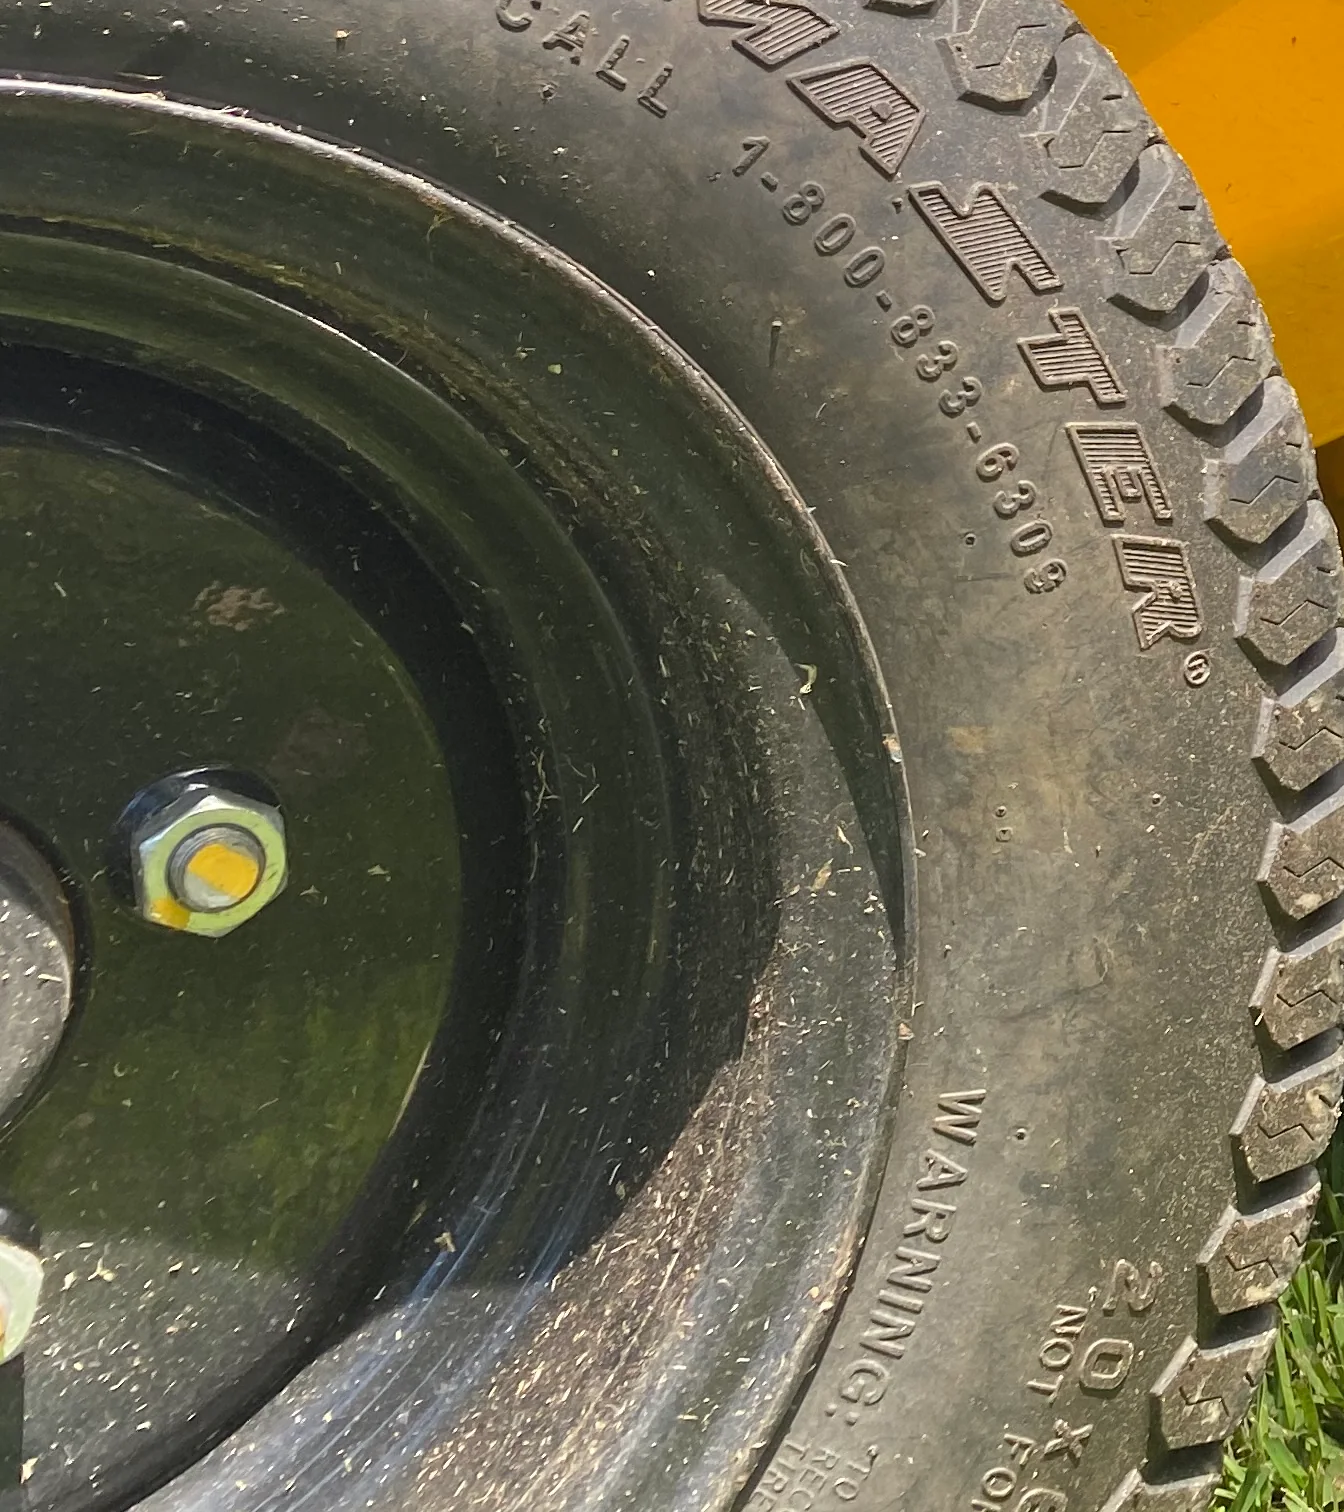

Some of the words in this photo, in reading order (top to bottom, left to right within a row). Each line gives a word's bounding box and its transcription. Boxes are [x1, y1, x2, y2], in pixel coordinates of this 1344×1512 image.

[731, 134, 1070, 596] 1-800-833-6309
[824, 1088, 988, 1427] WARNING:
[1025, 1303, 1089, 1407] NOT
